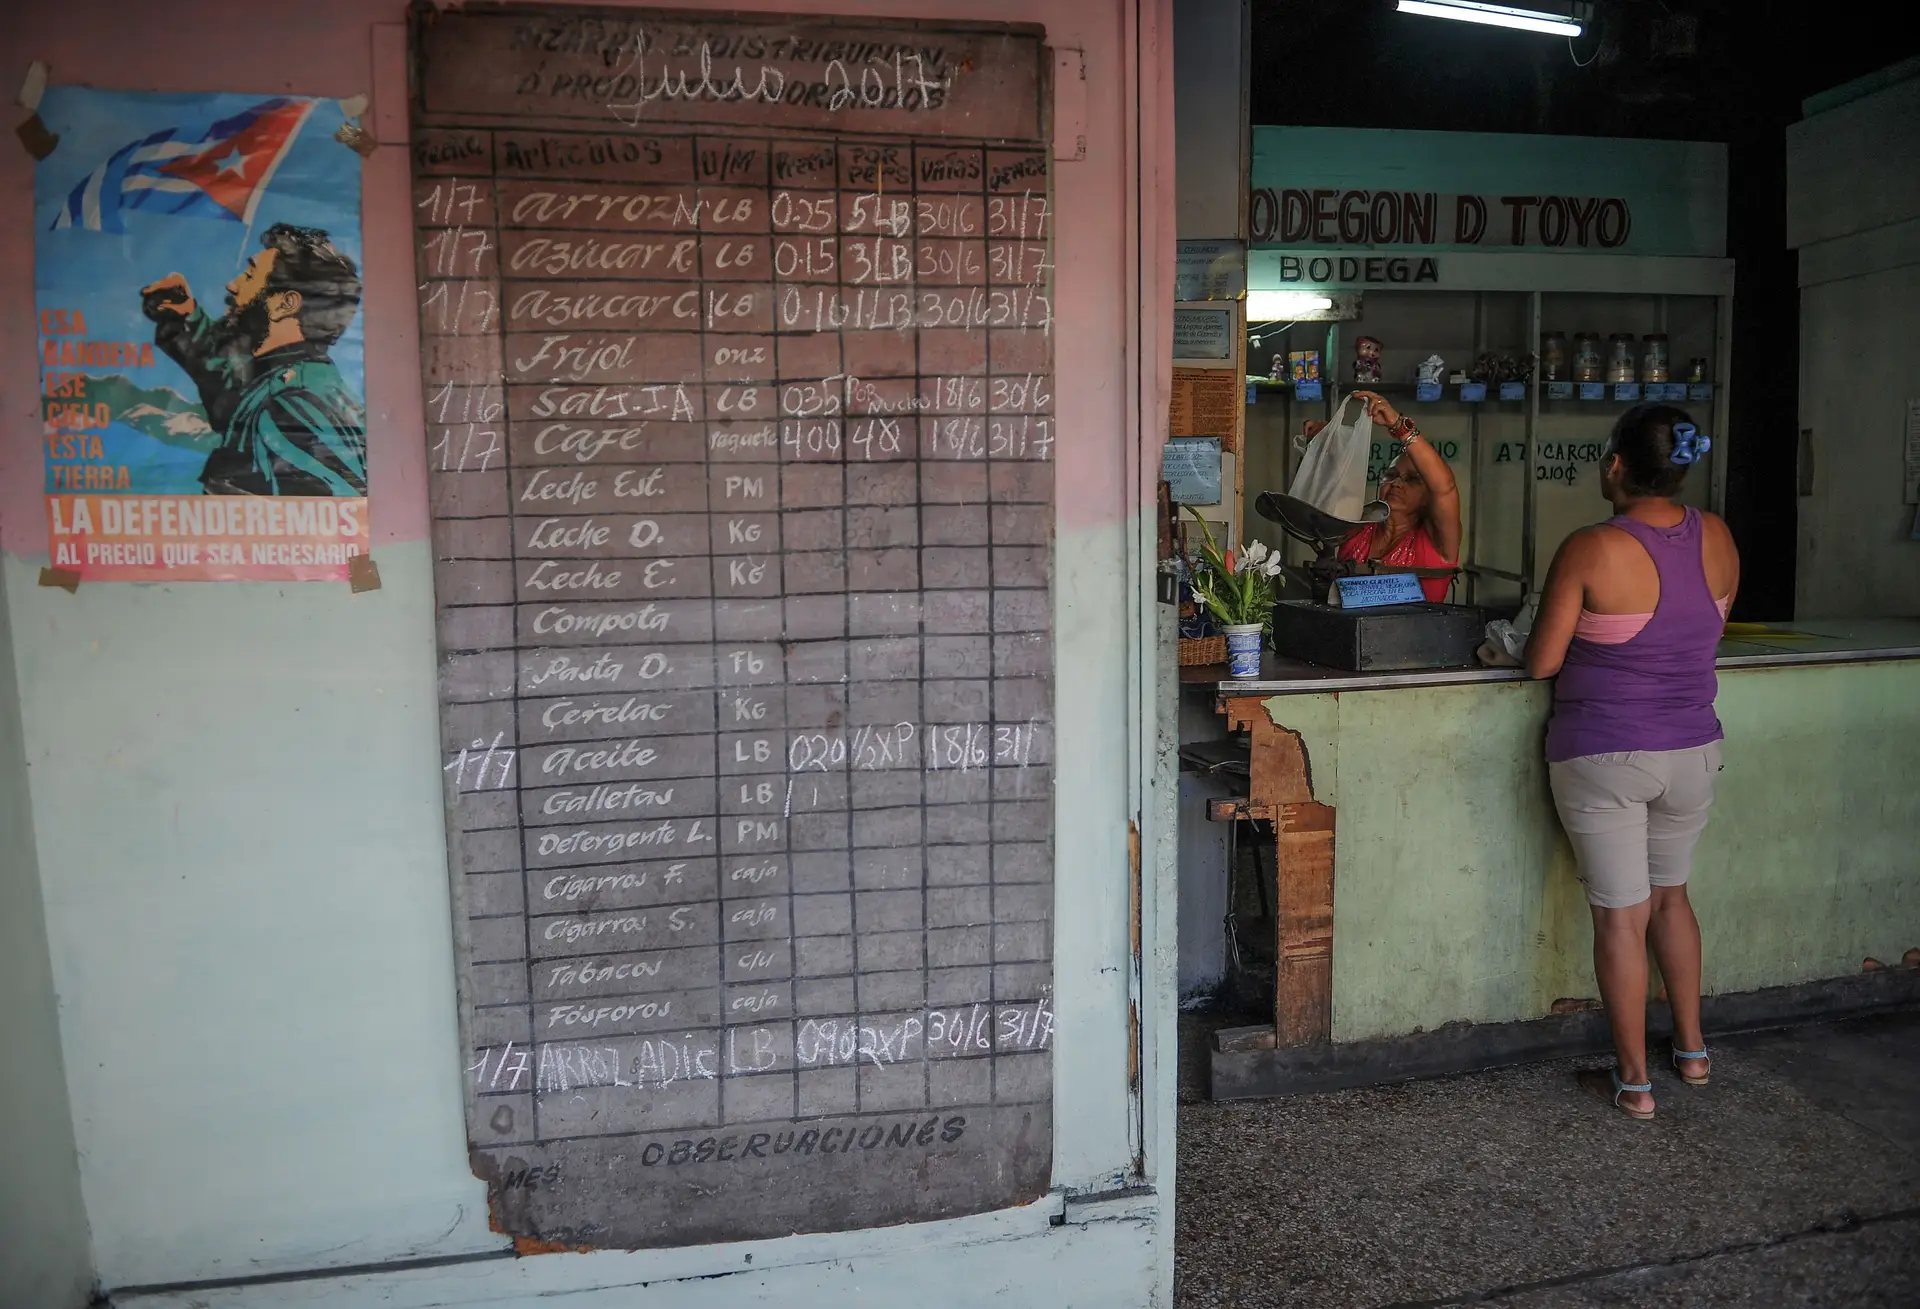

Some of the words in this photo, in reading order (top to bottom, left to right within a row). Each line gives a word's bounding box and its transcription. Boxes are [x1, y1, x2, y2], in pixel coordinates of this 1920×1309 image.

[823, 48, 953, 112] 2017
[418, 177, 484, 224] 1/7
[917, 192, 976, 236] 30/6
[989, 188, 1052, 239] 31/7
[1252, 187, 1438, 246] ODEGON
[1455, 194, 1488, 245] D
[1500, 195, 1633, 249] TOYO
[423, 224, 494, 276] 1/7
[918, 242, 980, 284] 30/6
[989, 239, 1055, 284] 31/7
[1279, 256, 1440, 285] BODEGA
[41, 308, 87, 337] ESA
[42, 340, 156, 369] BANDERA
[44, 371, 87, 399] ESE
[990, 372, 1051, 412] 30/6
[47, 402, 111, 430] CIELO
[50, 433, 105, 460] ESTA
[433, 421, 501, 474] 1/7
[52, 465, 132, 490] TIERRA
[724, 475, 764, 499] PM
[50, 497, 95, 536] LA
[101, 498, 361, 537] DEFENDEREMOS
[55, 543, 82, 566] AL
[87, 542, 156, 566] PRECIO
[161, 542, 200, 569] QUE
[206, 542, 244, 566] SEA
[251, 542, 360, 566] NECESARIO
[734, 739, 773, 763] LB
[740, 782, 774, 806] LB
[736, 819, 780, 844] PM
[730, 861, 780, 885] caja
[730, 903, 778, 927] caja
[730, 987, 780, 1012] caja
[464, 1040, 529, 1091] 1/7
